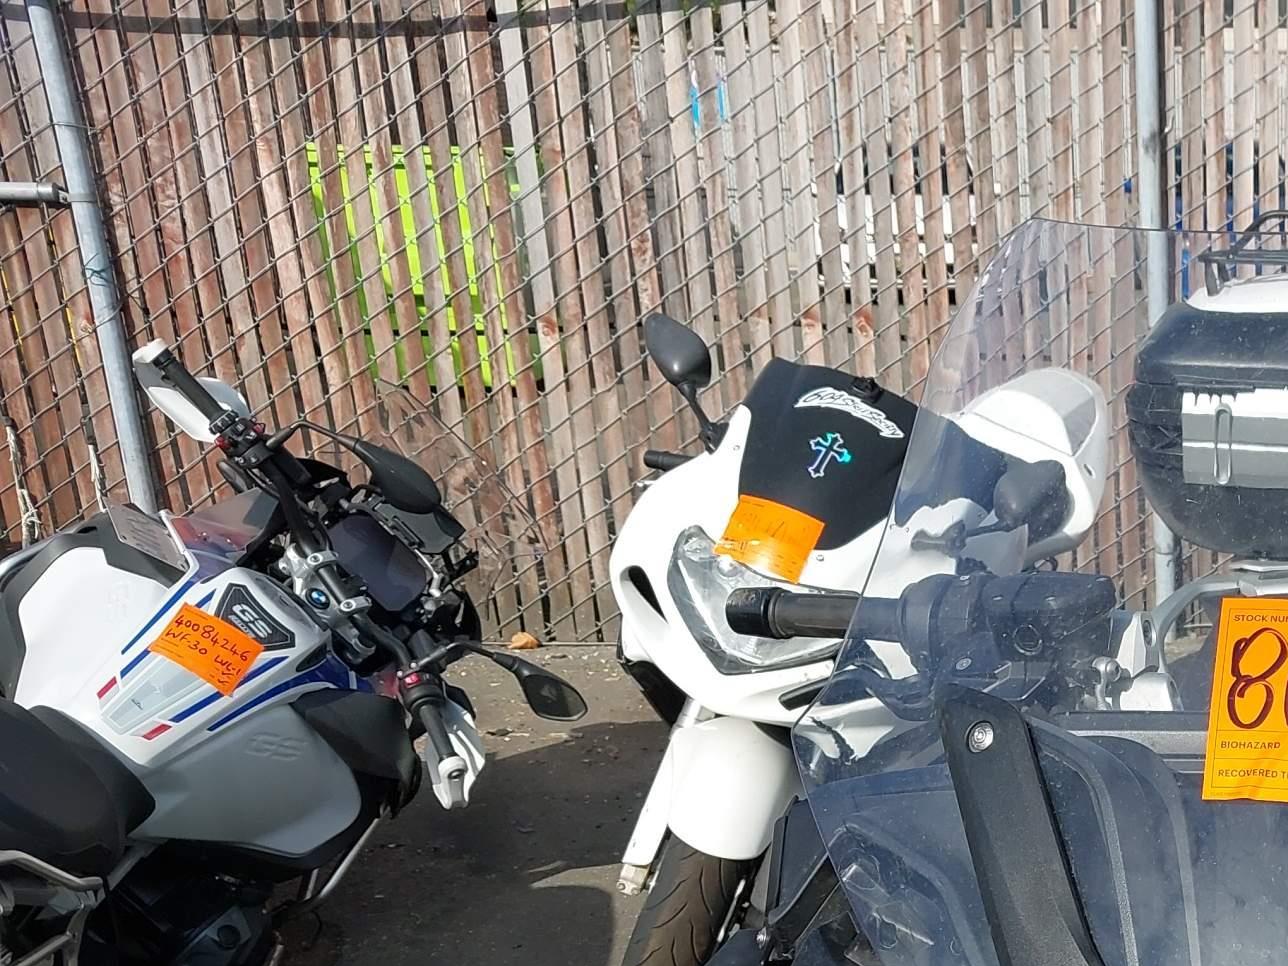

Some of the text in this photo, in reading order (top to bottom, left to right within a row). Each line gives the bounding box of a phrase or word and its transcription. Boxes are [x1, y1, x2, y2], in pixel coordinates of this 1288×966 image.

[232, 603, 273, 639] GS
[1233, 613, 1269, 623] STOCK
[174, 615, 251, 662] 40084246
[1220, 740, 1281, 750] BIOHAZARD
[1217, 768, 1278, 779] RECOVERED
